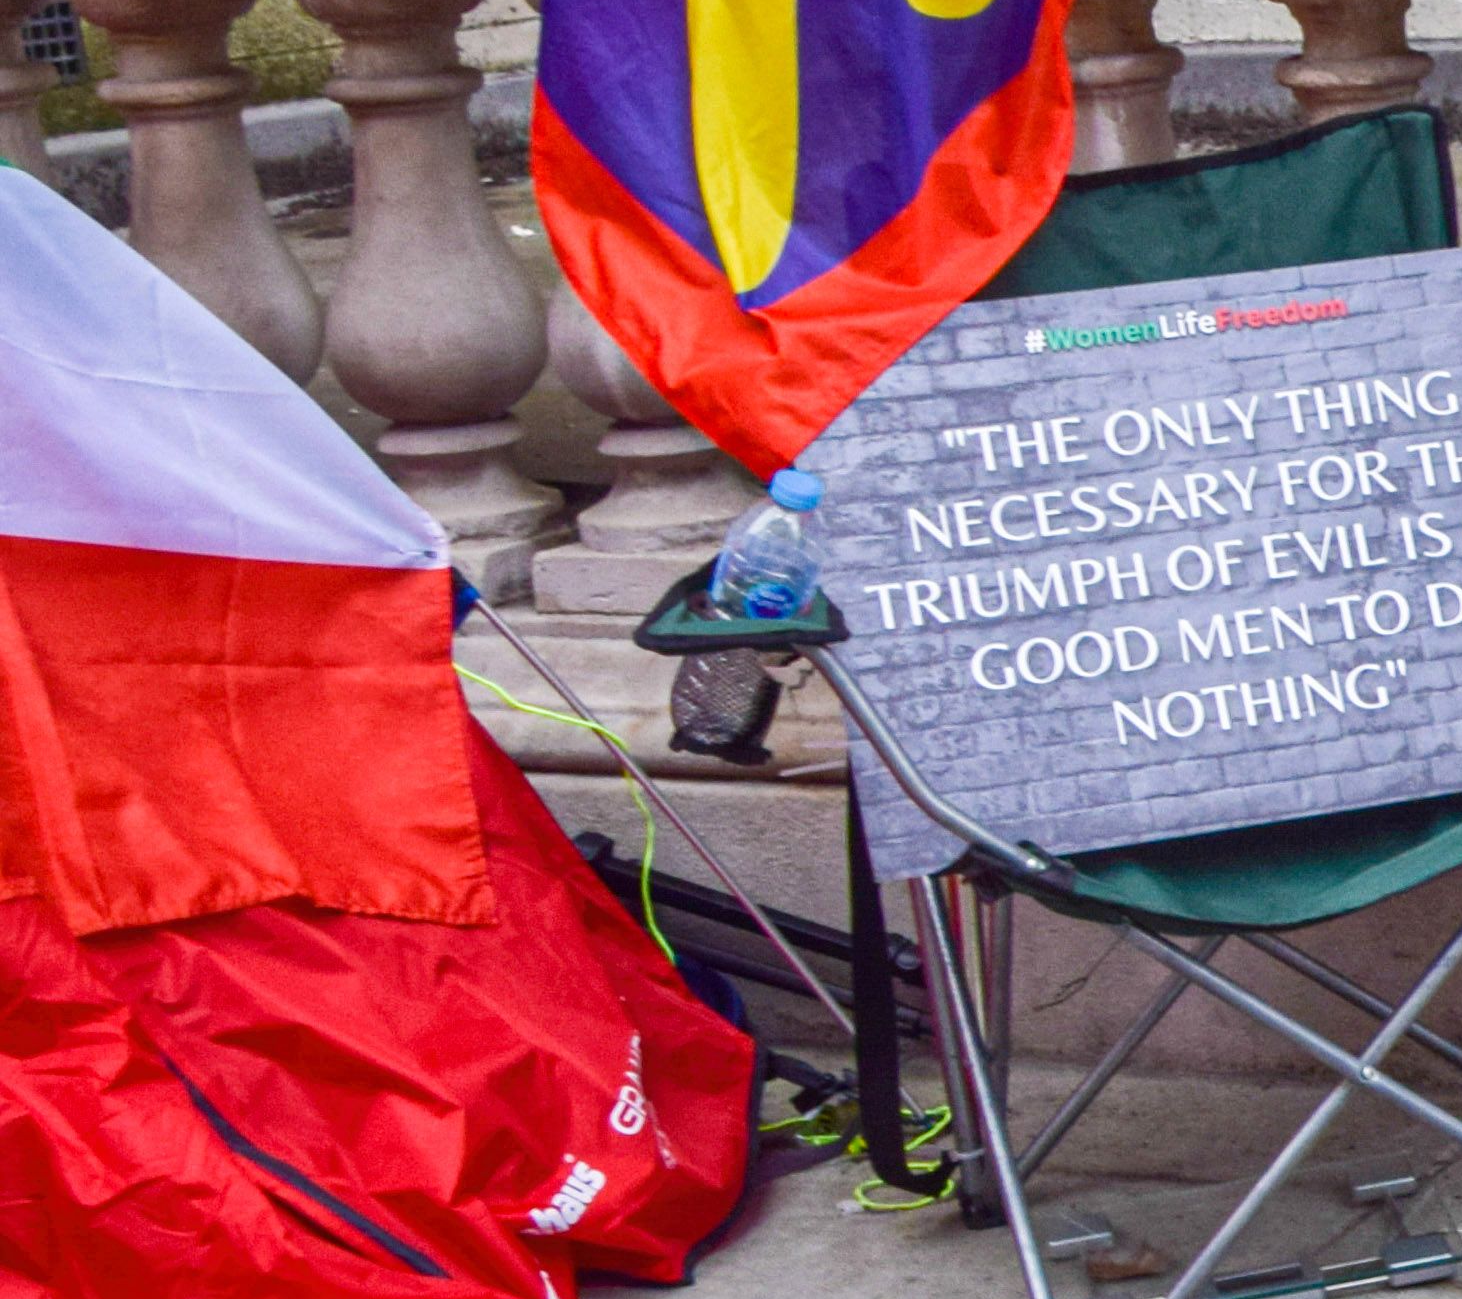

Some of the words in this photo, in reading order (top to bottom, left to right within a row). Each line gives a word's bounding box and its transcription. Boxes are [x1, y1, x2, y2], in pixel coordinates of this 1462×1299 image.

[1024, 296, 1348, 355] #WomenLifeFreedom
[1103, 395, 1260, 456] ONLY
[1276, 370, 1459, 431] THING
[906, 467, 1258, 552] NECESSARY
[1279, 448, 1396, 508] FOR
[864, 550, 1150, 632] TRIUMPH
[1167, 538, 1243, 591] OF
[1263, 515, 1386, 580] EVIL
[1401, 509, 1452, 560] IS
[970, 626, 1158, 690] GOOD
[1179, 602, 1315, 663] MEN
[1325, 587, 1411, 640] TO
